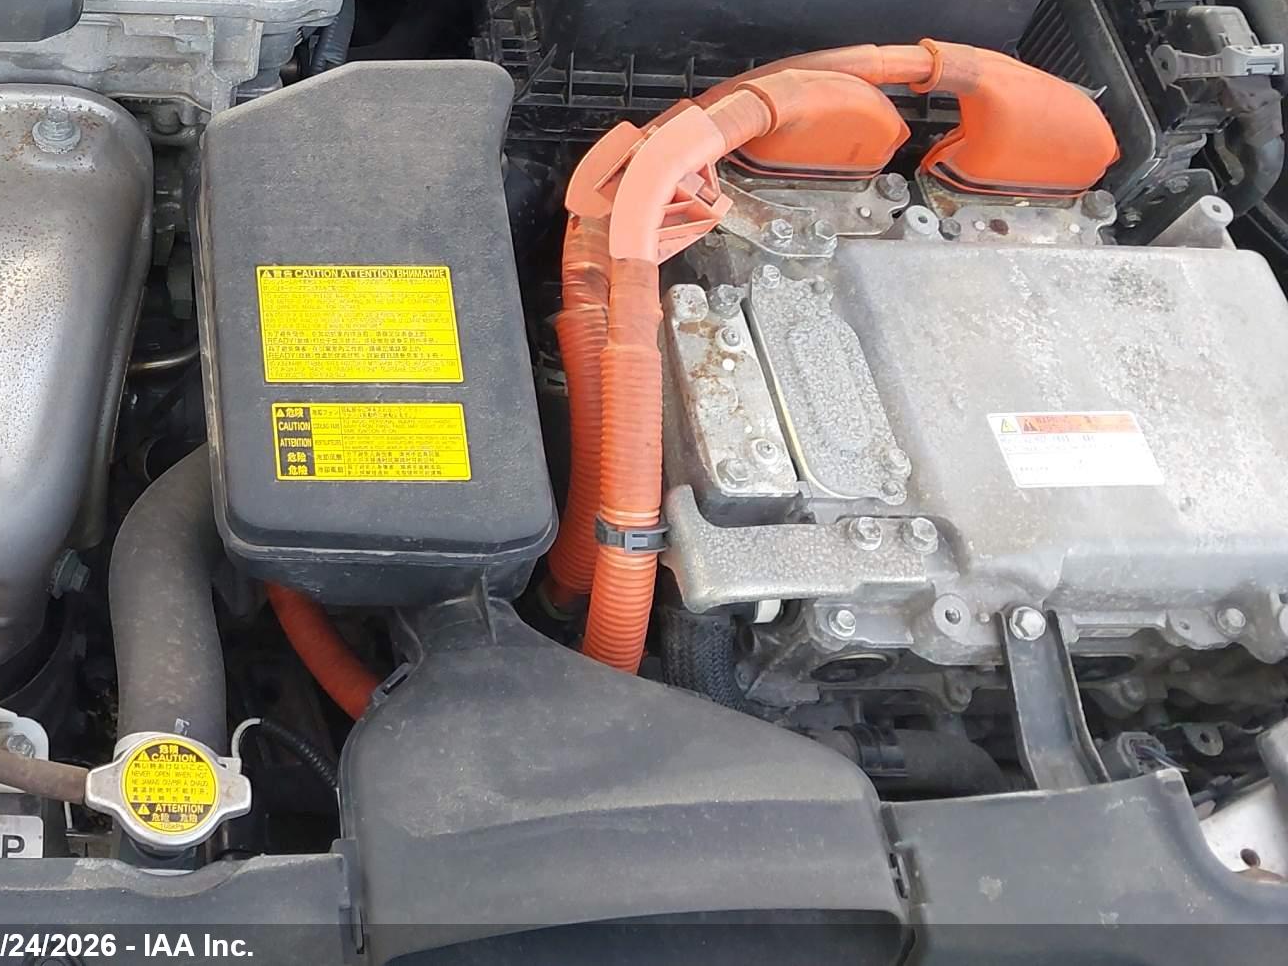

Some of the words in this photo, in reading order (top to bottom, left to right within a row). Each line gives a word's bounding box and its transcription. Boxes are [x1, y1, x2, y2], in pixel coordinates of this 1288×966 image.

[294, 269, 338, 278] CAUTION
[340, 269, 395, 279] ATTENTION
[396, 269, 445, 279] ВНИМАНИЕ
[278, 421, 310, 431] CAUTION
[280, 437, 312, 447] ATTENTION
[152, 753, 197, 762] CAUTION
[155, 804, 204, 814] ATTENTION
[2, 834, 25, 859] P
